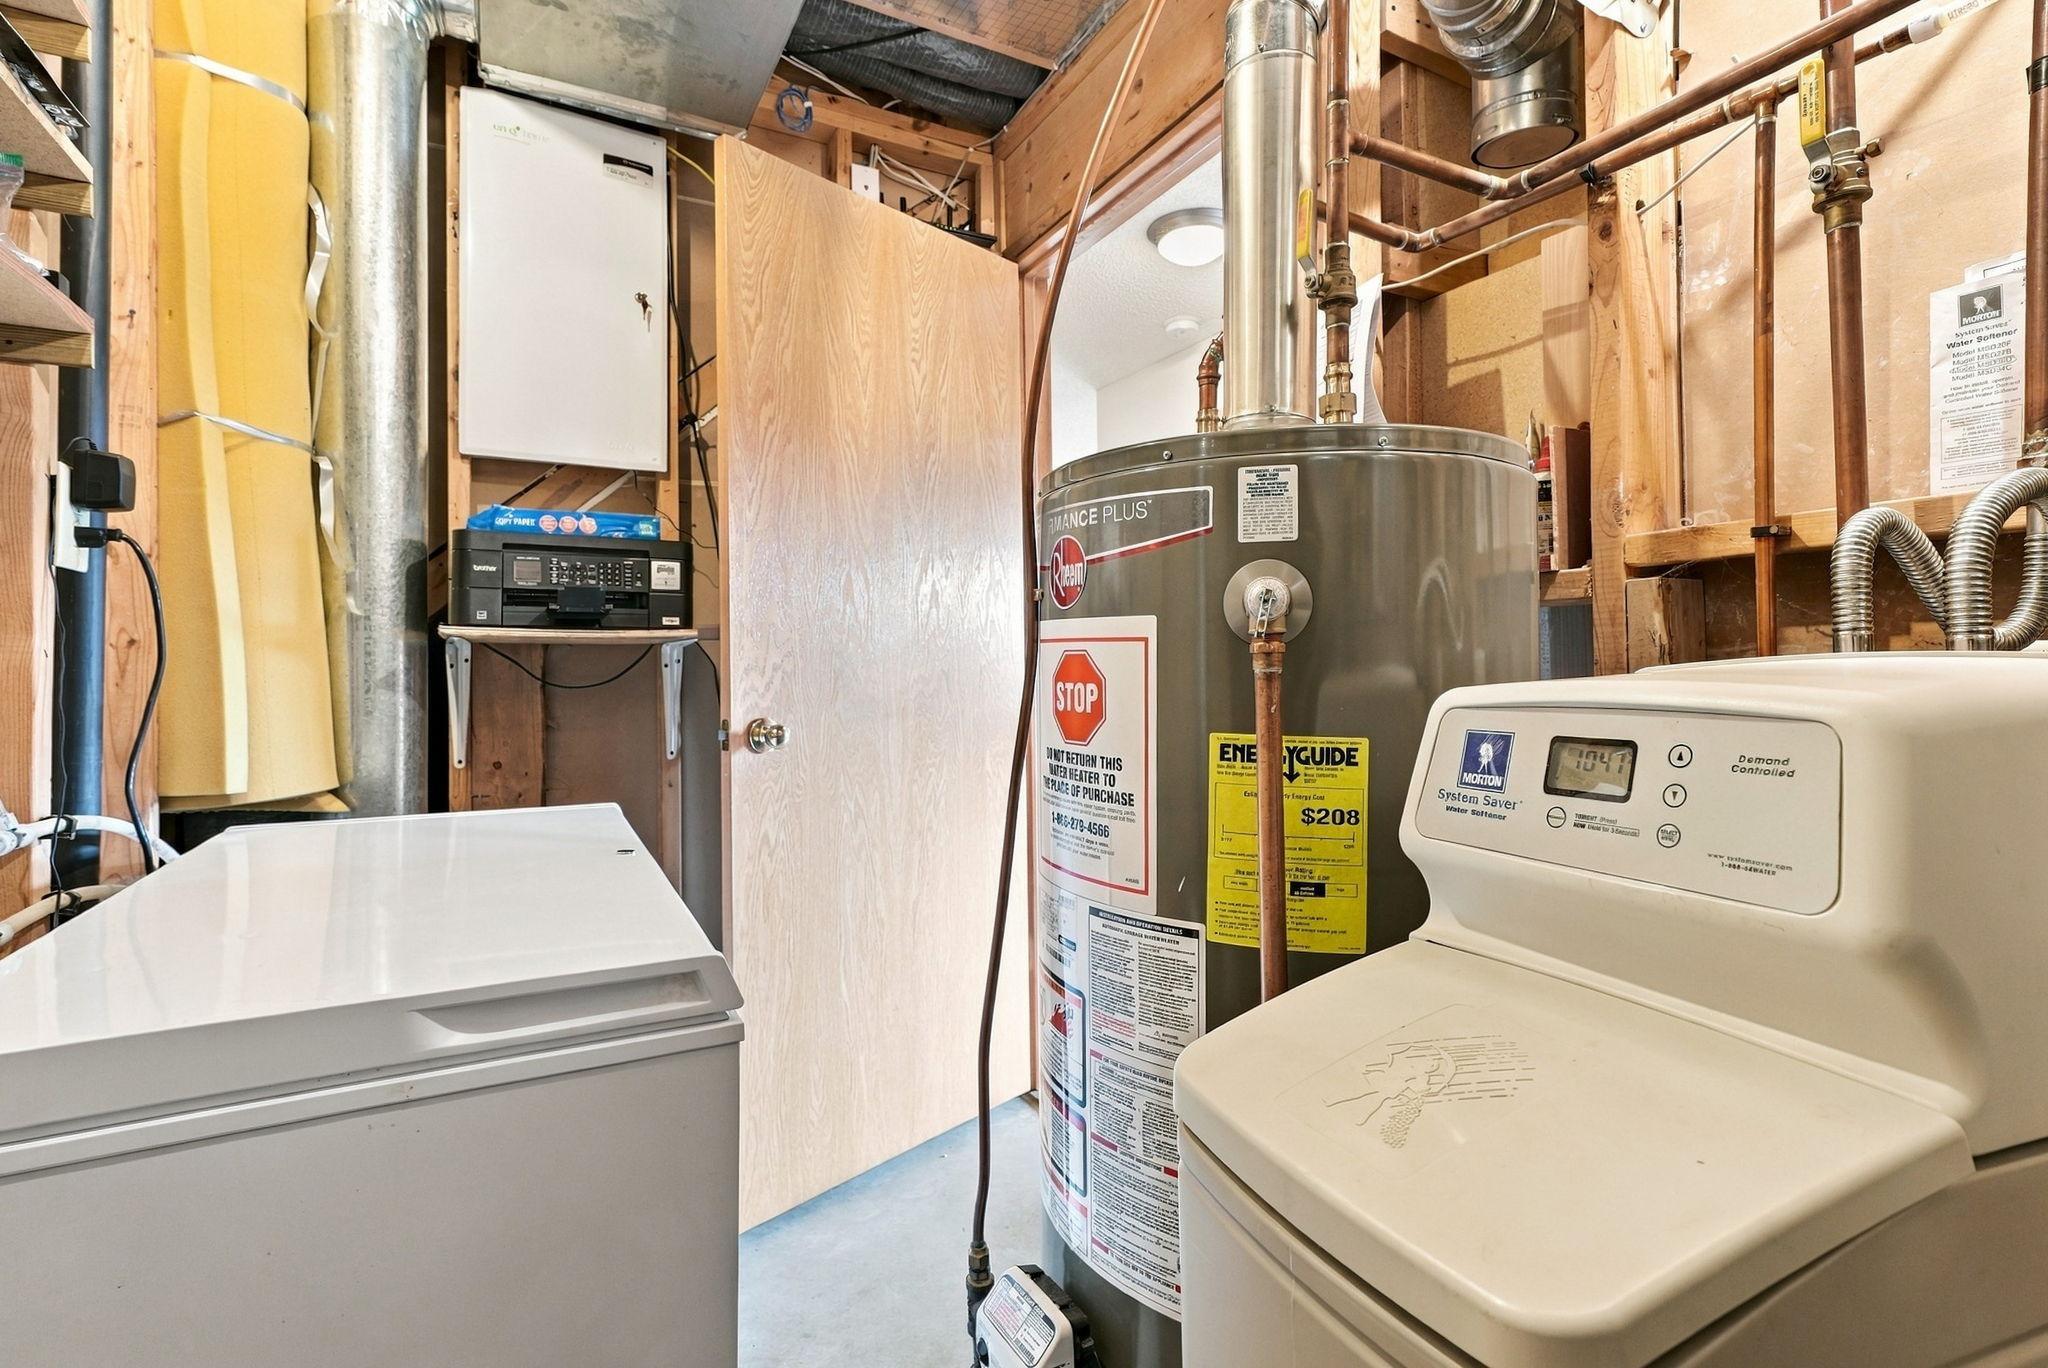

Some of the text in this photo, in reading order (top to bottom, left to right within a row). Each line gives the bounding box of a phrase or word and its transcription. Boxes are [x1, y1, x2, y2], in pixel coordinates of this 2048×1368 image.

[1961, 310, 2001, 326] MORTON
[1946, 328, 2018, 350] Water Softener
[1955, 327, 1984, 339] System
[1052, 540, 1085, 598] Rheem
[1056, 681, 1099, 714] STOP
[1053, 748, 1065, 763] NOT
[1065, 750, 1097, 768] RETURN
[1099, 756, 1123, 772] THIS
[1738, 754, 1791, 766] Demand
[1068, 767, 1100, 787] HEATER
[1102, 773, 1116, 788] TO
[1462, 772, 1503, 787] MORTON
[1731, 764, 1796, 778] Controlled
[1070, 784, 1082, 798] OF
[1082, 786, 1135, 807] PURCHASE
[1437, 788, 1518, 810] System Saver
[1301, 806, 1360, 826] $208
[1445, 804, 1507, 821] Water Softener
[1573, 821, 1586, 829] NOW
